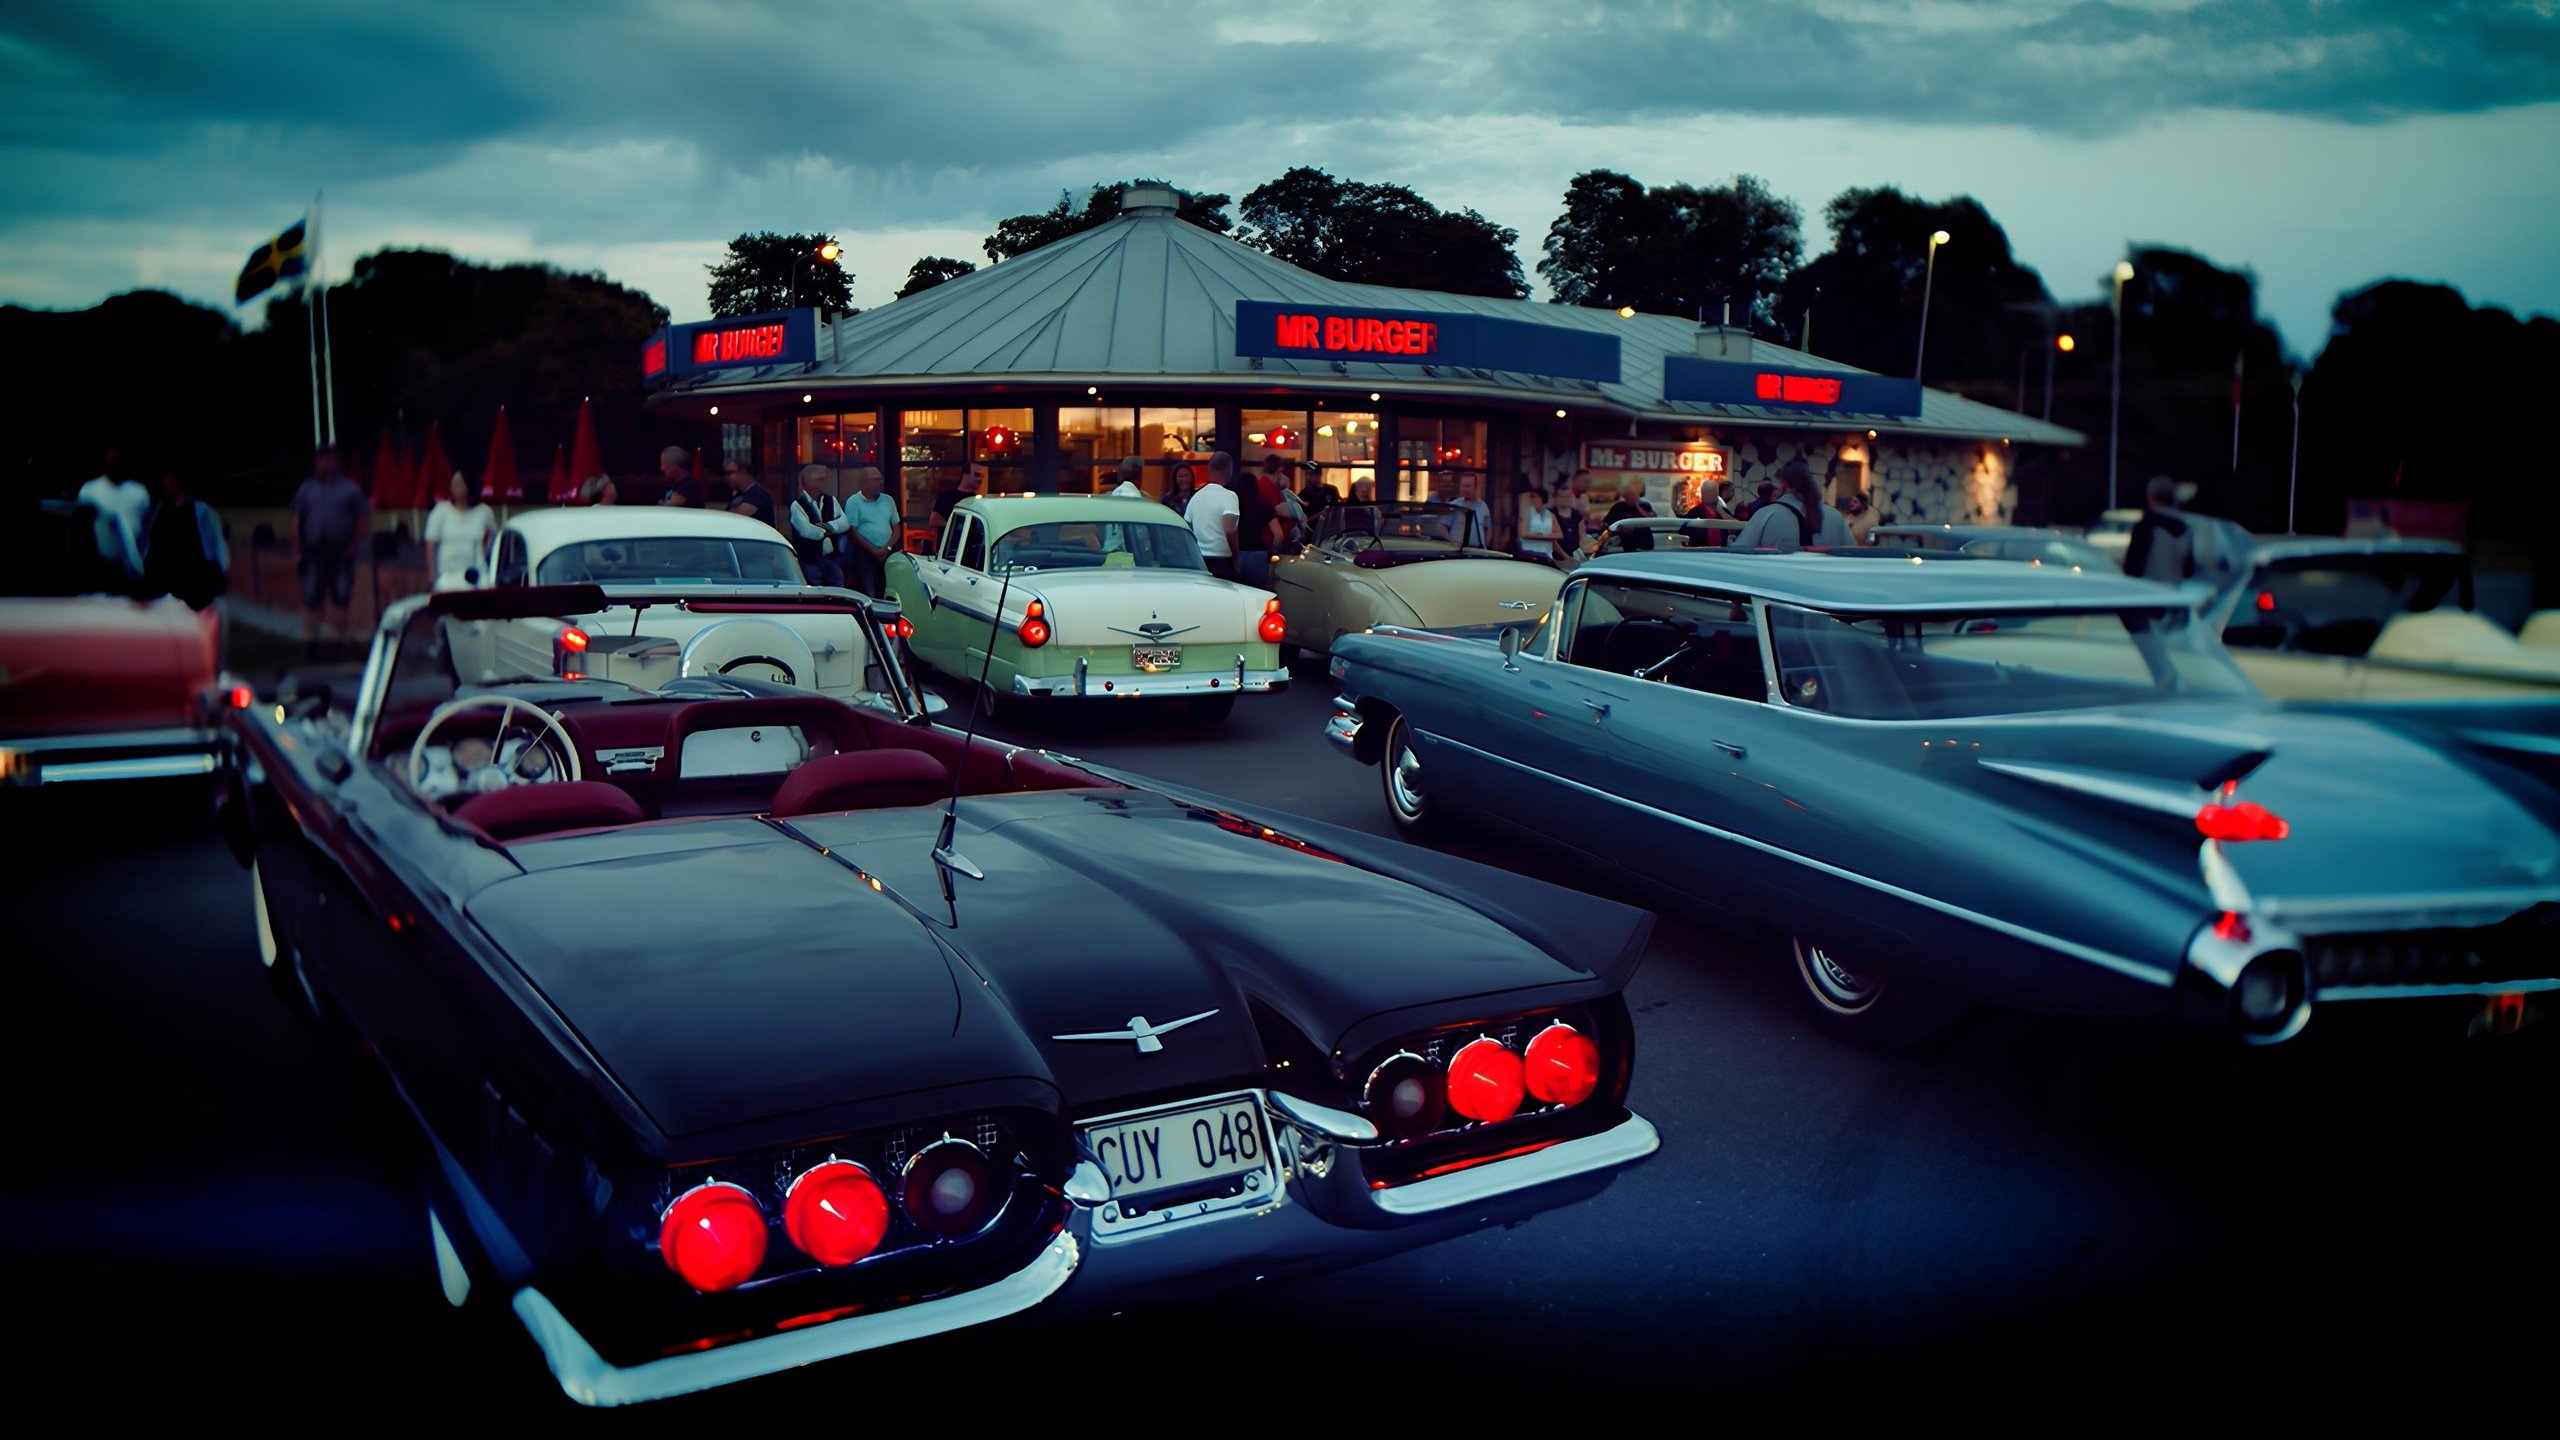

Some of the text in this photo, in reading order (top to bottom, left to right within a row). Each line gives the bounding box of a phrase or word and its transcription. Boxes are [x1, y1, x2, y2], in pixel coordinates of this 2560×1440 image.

[1276, 314, 1320, 349] MR
[1590, 448, 1723, 472] Mr BURGER
[1097, 1110, 1258, 1187] CUY 048
